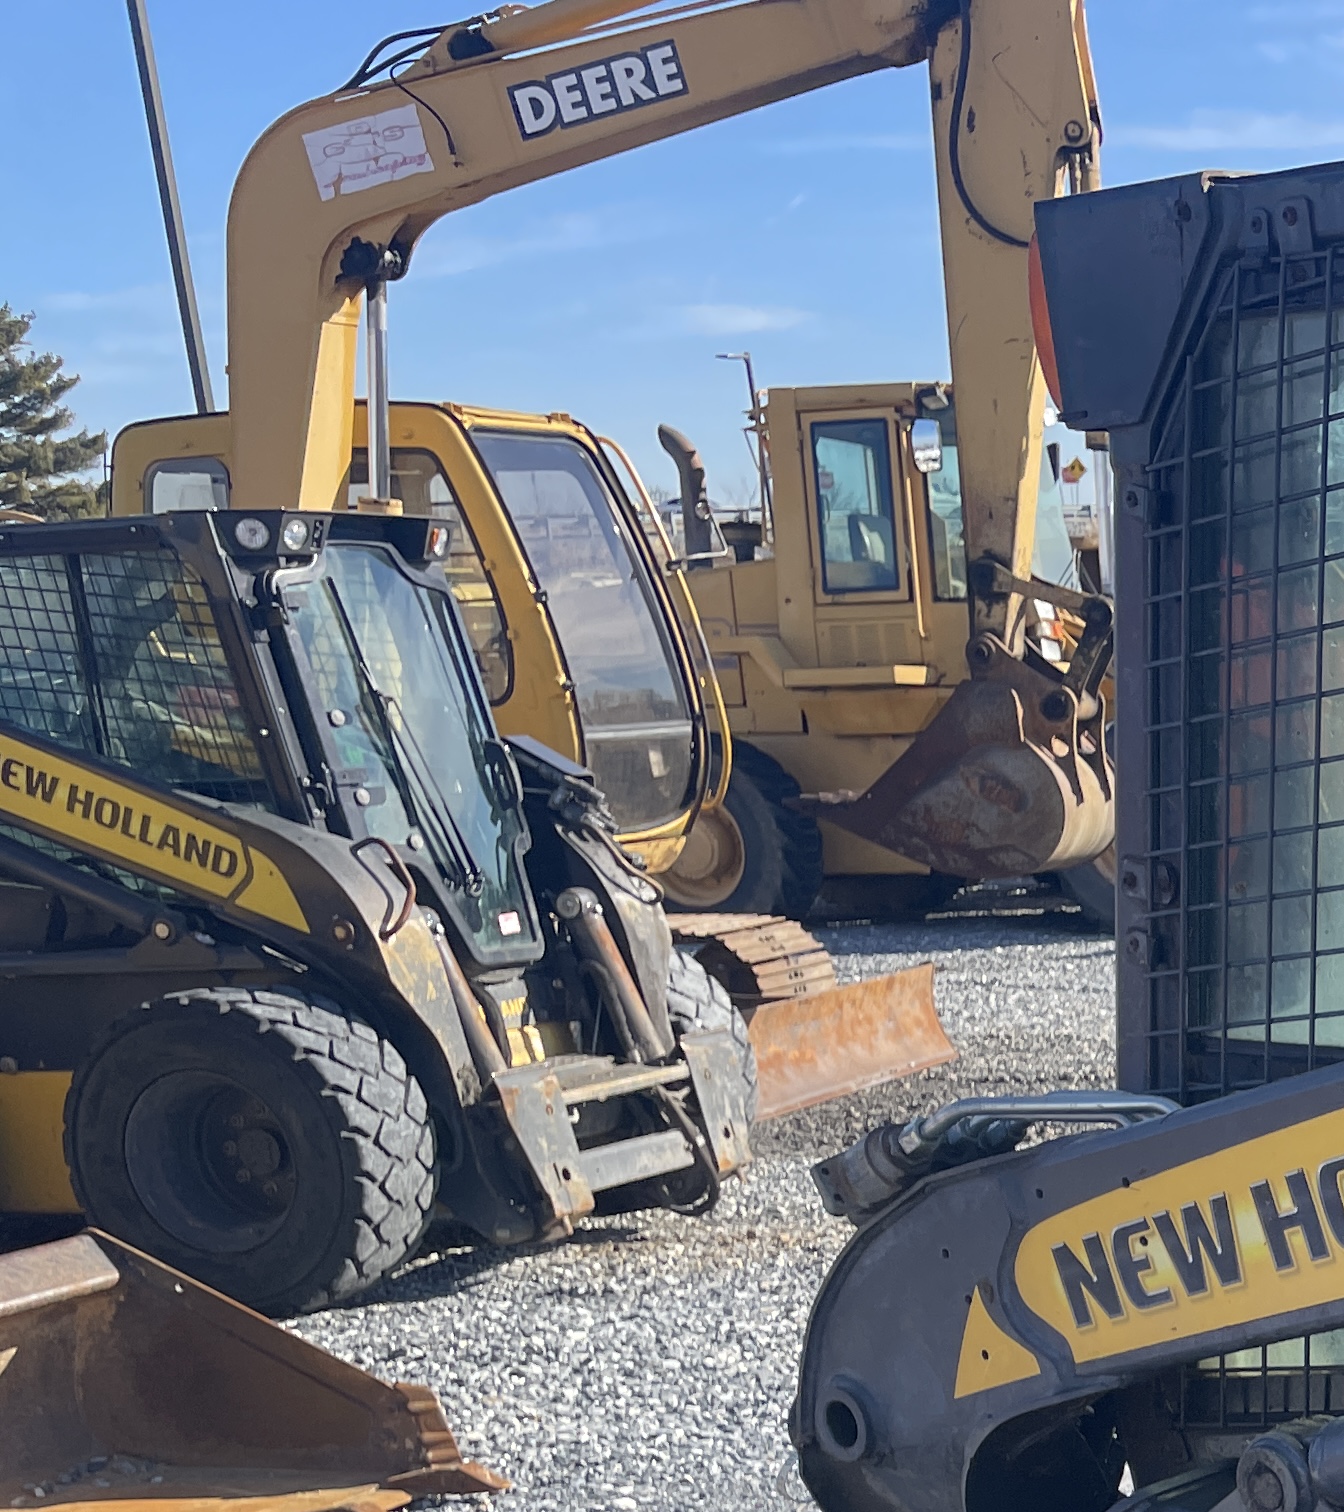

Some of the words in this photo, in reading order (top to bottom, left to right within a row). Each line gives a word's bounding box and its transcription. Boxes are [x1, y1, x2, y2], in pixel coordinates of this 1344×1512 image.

[513, 44, 684, 135] DEERE
[0, 758, 60, 804] EW
[66, 783, 238, 879] HOLLAND
[1051, 1190, 1243, 1329] NEW
